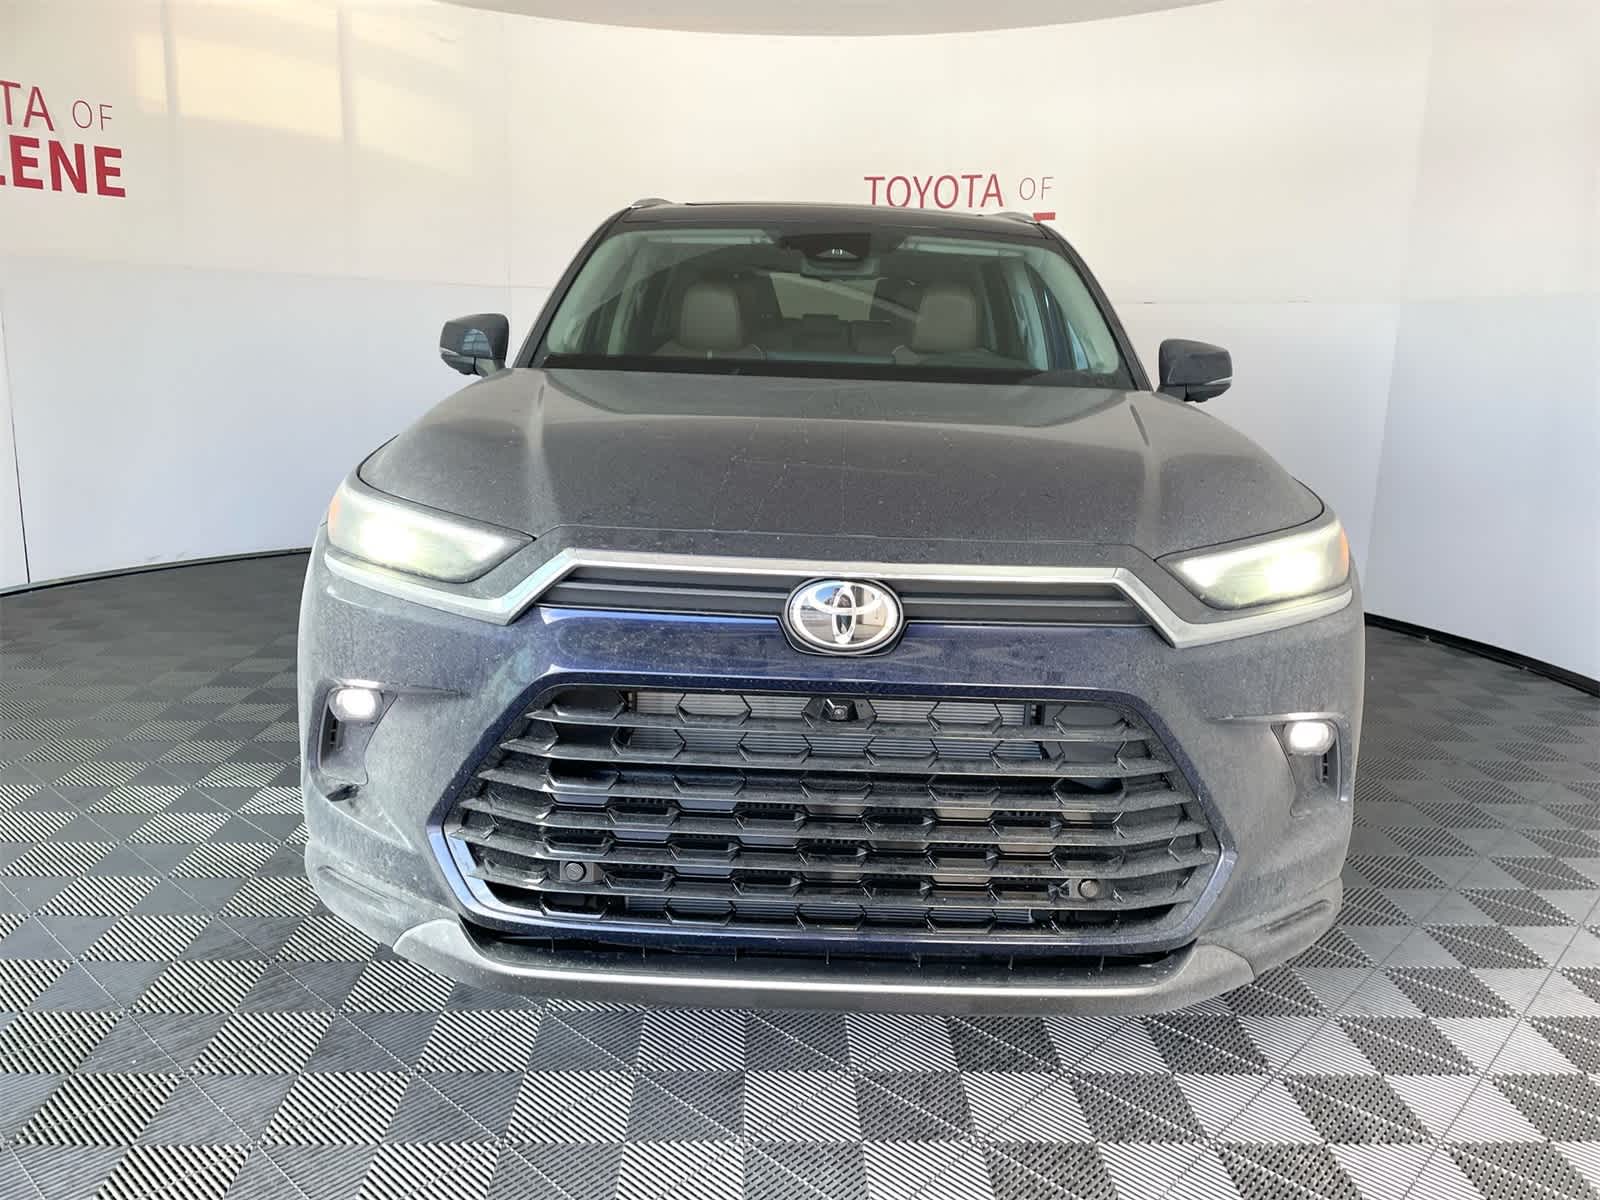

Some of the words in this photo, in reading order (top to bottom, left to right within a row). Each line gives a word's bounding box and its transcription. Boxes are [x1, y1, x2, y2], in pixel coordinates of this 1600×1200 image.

[72, 100, 112, 130] OF
[0, 134, 126, 197] ENE
[864, 174, 1003, 208] TOYOTA
[1019, 176, 1054, 200] OF
